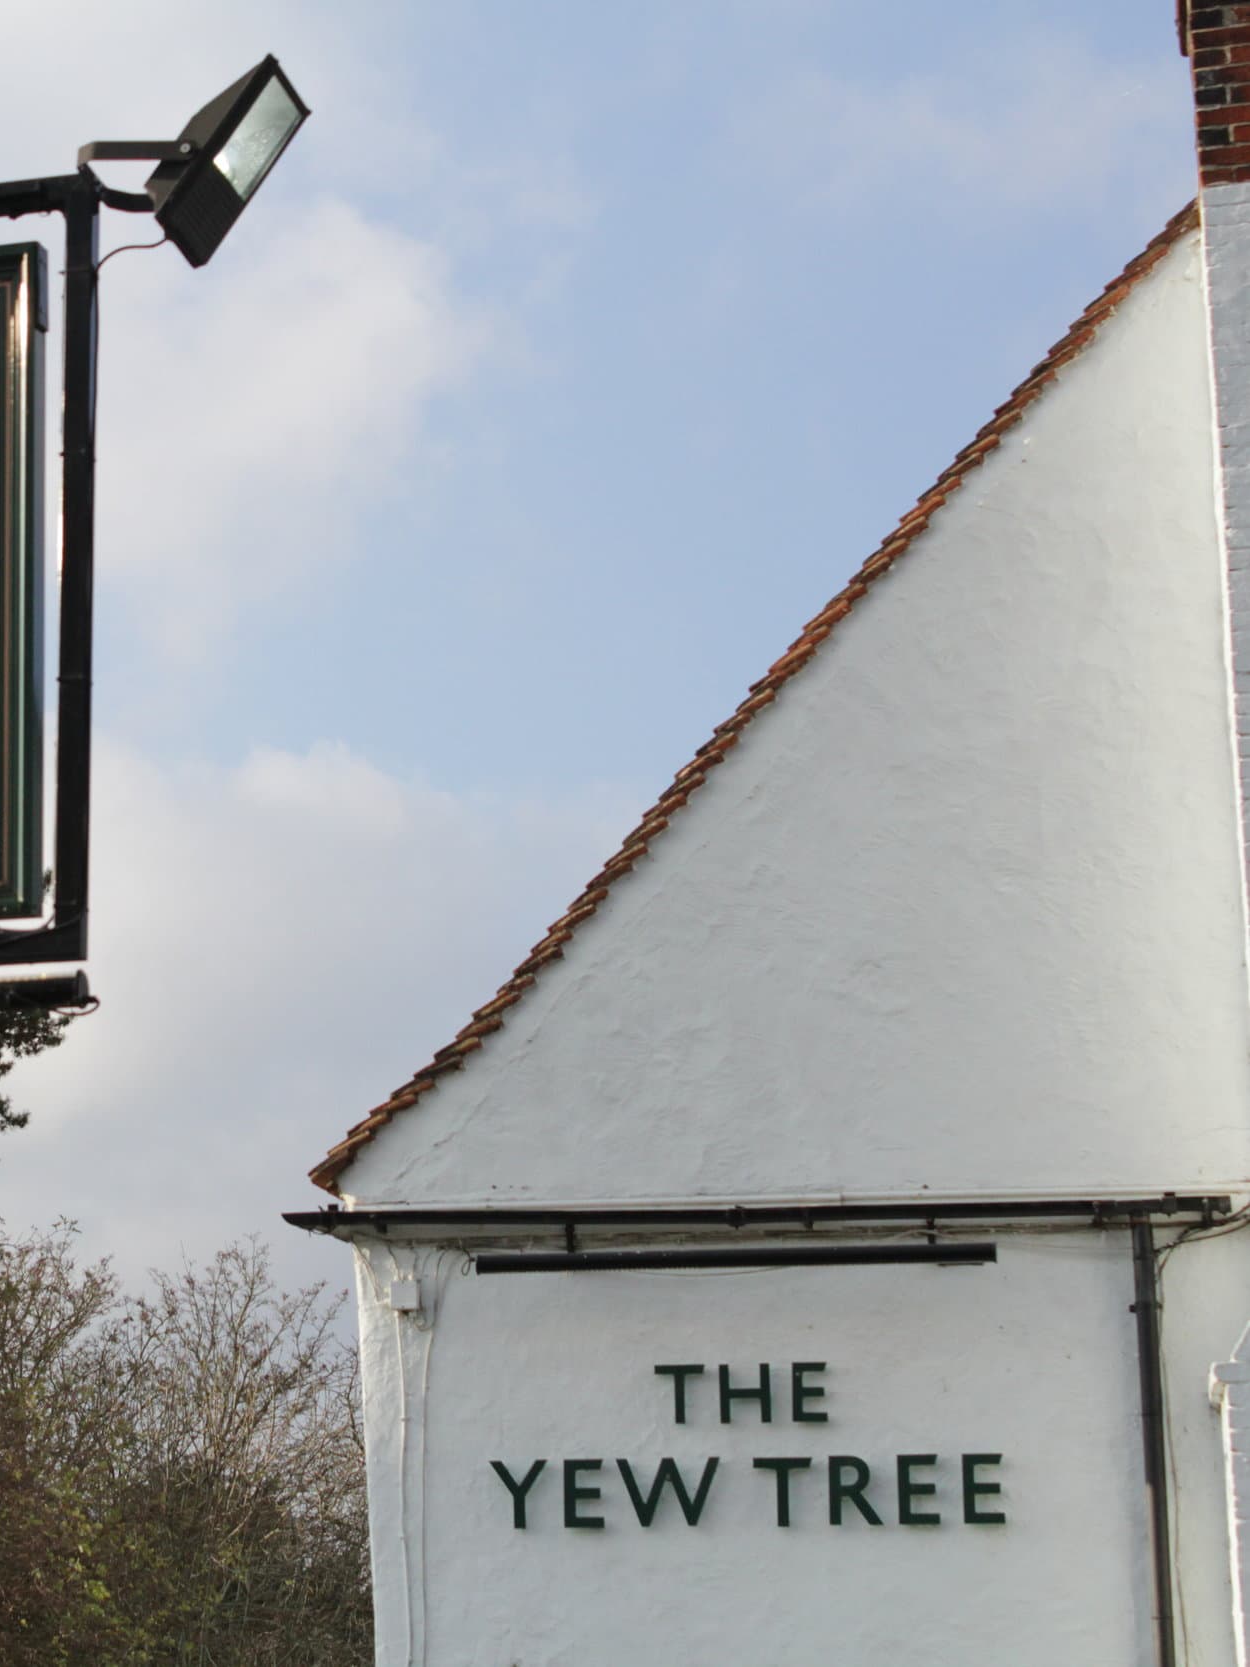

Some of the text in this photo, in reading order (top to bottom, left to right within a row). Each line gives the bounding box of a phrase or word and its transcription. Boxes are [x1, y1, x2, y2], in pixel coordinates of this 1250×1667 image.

[654, 1361, 829, 1424] THE
[489, 1453, 1007, 1530] YEW TREE
